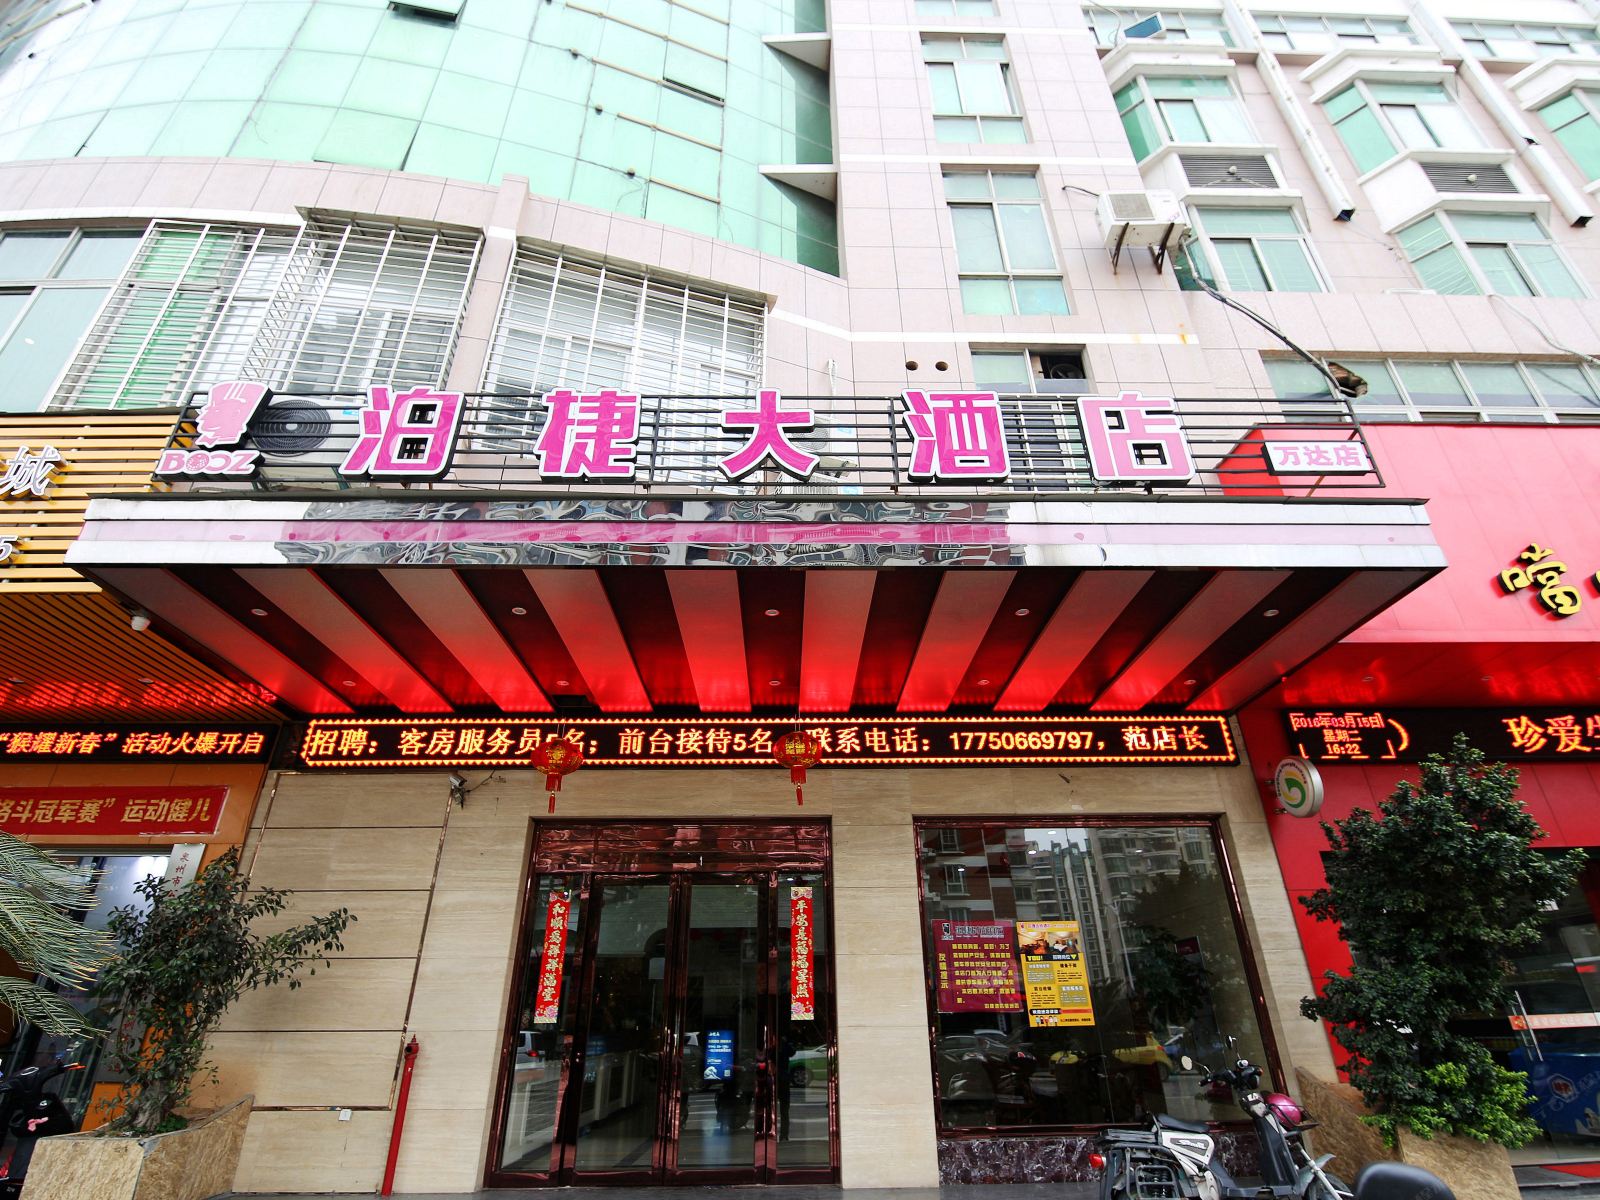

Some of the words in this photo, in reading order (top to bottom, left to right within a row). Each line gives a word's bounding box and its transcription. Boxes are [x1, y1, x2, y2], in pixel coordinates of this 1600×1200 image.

[338, 384, 1196, 482] 泊捷大酒店
[1272, 444, 1363, 468] 万达店
[0, 444, 60, 496] 城
[1323, 729, 1362, 742] 星期二
[1326, 743, 1361, 754] 16:22
